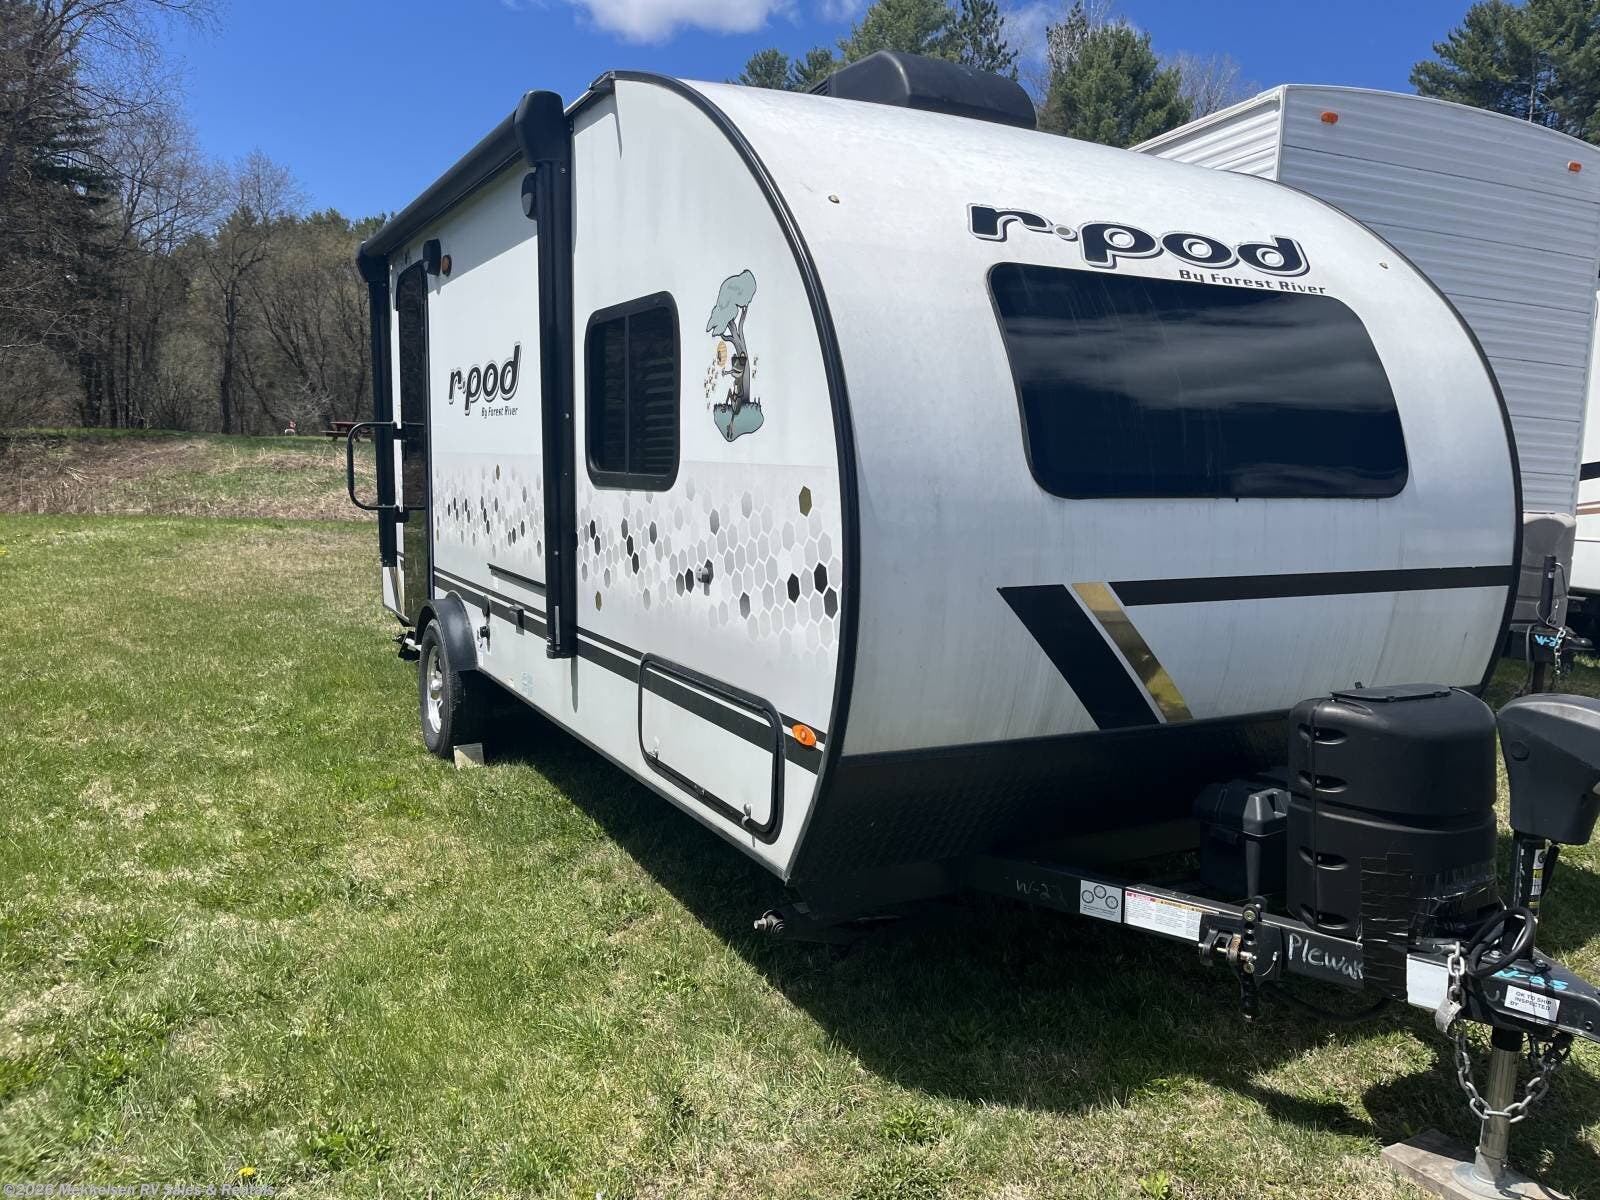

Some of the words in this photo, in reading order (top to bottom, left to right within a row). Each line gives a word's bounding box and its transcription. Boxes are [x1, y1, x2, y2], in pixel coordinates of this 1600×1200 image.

[1178, 269, 1205, 283] By
[1210, 273, 1275, 289] Forest
[1278, 280, 1327, 294] River
[481, 406, 488, 419] By
[488, 406, 504, 417] Forest
[504, 405, 519, 416] River
[1514, 996, 1551, 1011] INSPECTED
[1515, 991, 1526, 999] OK
[1536, 997, 1552, 1006] SHIP
